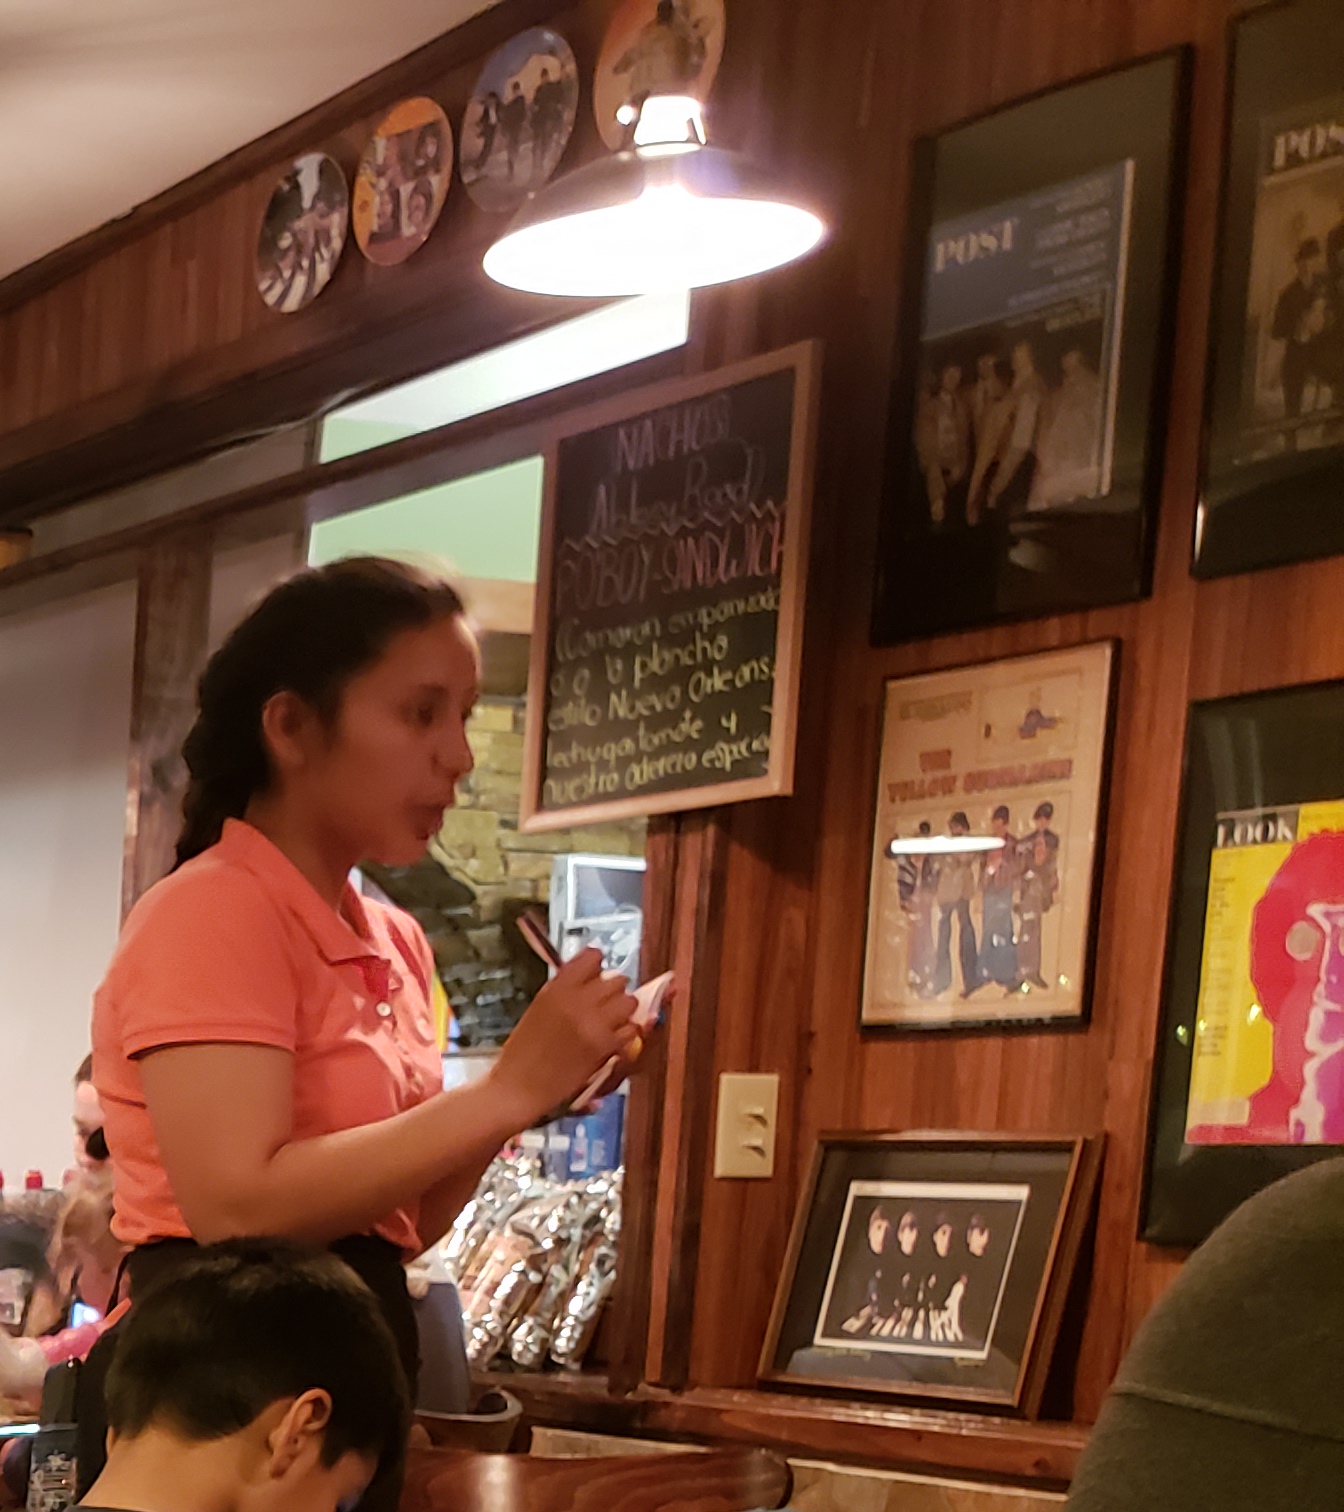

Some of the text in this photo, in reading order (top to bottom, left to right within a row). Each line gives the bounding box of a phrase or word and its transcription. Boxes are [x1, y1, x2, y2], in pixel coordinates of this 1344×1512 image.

[934, 217, 1020, 274] POST
[608, 685, 682, 721] Nuevo
[1217, 816, 1293, 849] LOOK
